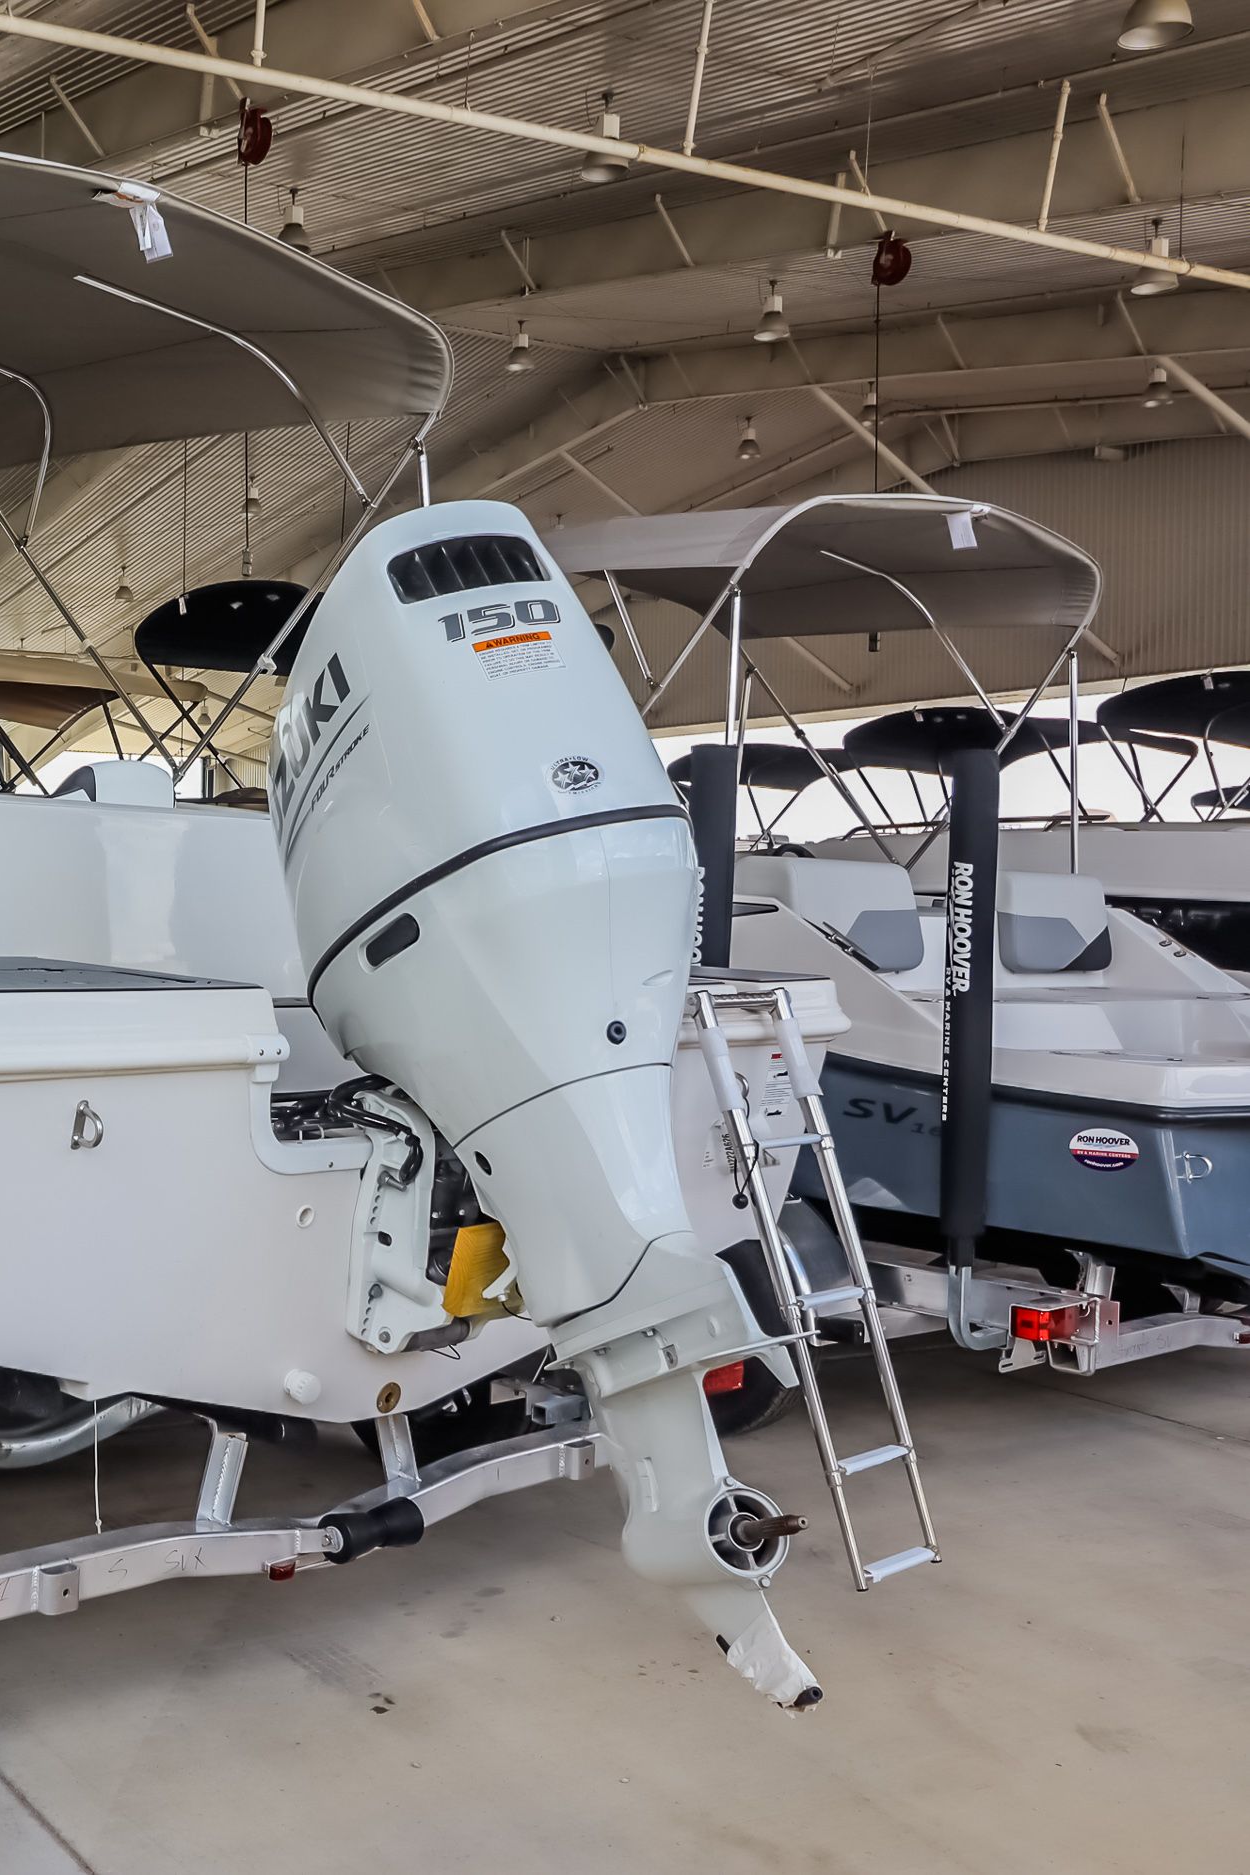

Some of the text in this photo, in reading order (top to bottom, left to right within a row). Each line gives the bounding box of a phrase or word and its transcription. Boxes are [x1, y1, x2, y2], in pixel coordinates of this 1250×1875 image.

[437, 599, 561, 643] 150
[493, 632, 541, 647] WARNING
[951, 861, 974, 995] RON HOOVER
[944, 1001, 952, 1055] MARINE
[843, 1098, 918, 1125] SV
[941, 1059, 950, 1122] CENTERS
[1076, 1134, 1131, 1146] RON HOOVER
